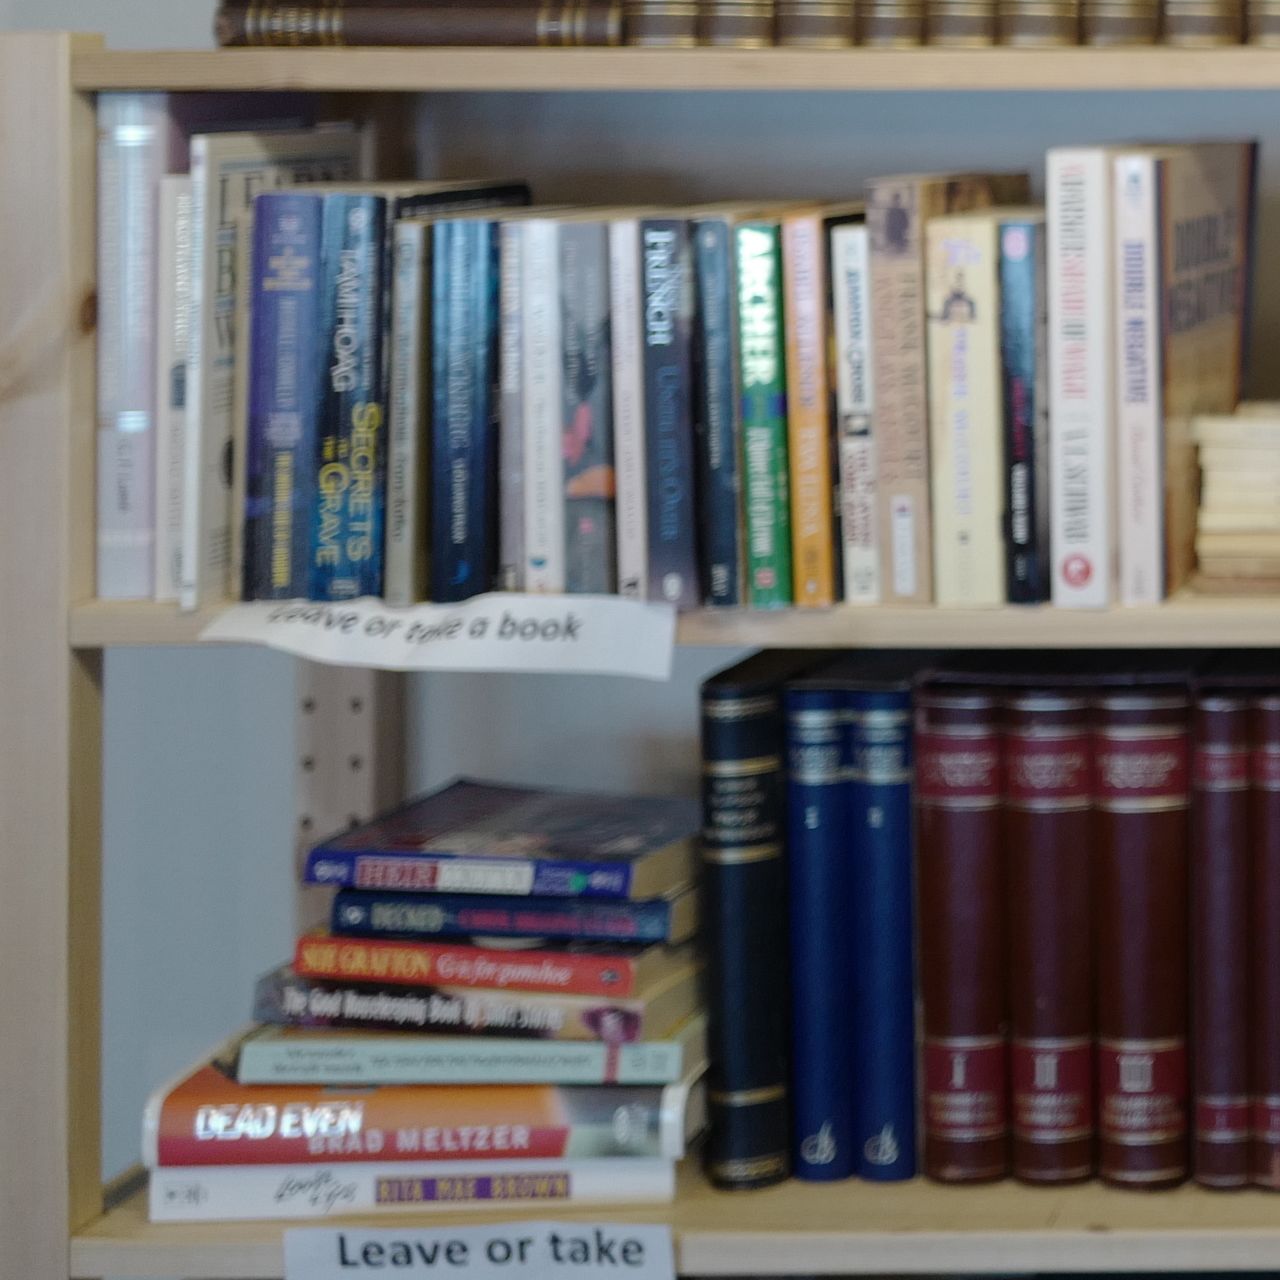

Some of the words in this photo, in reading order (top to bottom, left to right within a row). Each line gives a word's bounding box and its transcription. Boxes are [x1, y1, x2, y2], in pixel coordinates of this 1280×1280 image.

[337, 249, 359, 307] TAMI
[645, 229, 676, 346] FRENCH
[738, 228, 777, 387] ARCHER
[330, 308, 357, 393] HOAG
[347, 401, 382, 561] SECRETS
[316, 462, 351, 568] GRAVE
[365, 618, 400, 637] or
[404, 616, 462, 646] take
[469, 618, 487, 638] a
[499, 612, 584, 642] book
[340, 946, 431, 978] GRAFTON
[195, 1105, 275, 1141] DEAD
[281, 1101, 365, 1139] EVEN
[307, 1127, 384, 1155] BRAD
[397, 1124, 530, 1153] MELTZER
[377, 1175, 421, 1203] RITA
[436, 1175, 476, 1202] MAE
[490, 1172, 570, 1202] BROWN
[337, 1232, 469, 1269] Leave
[484, 1239, 531, 1266] or
[548, 1229, 646, 1267] take
